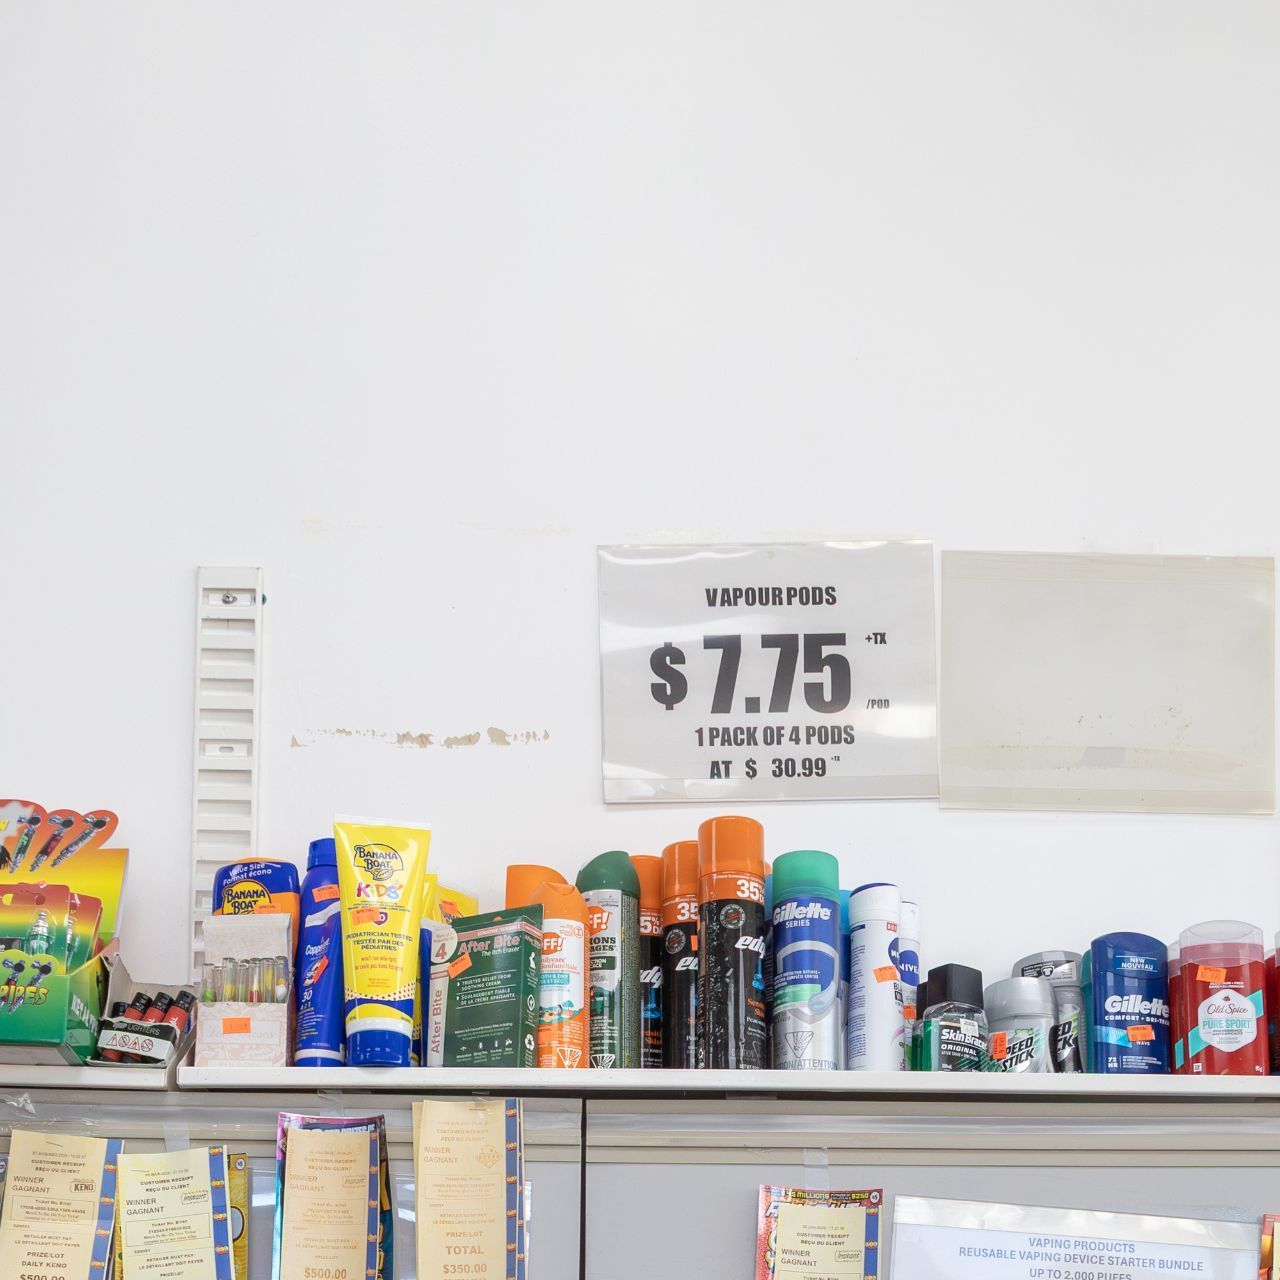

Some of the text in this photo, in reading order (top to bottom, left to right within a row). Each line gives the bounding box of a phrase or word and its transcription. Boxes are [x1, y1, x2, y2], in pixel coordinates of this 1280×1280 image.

[706, 586, 836, 607] VAPOUR PODS
[865, 633, 887, 645] +TX
[650, 633, 851, 713] $ 7.75
[867, 699, 890, 709] /POD
[695, 726, 855, 746] 1 PACK OF 4 PODS
[710, 758, 826, 779] AT $ 30.99
[357, 846, 398, 860] BANANA
[366, 859, 390, 869] BOAT
[773, 902, 831, 926] Gillette
[785, 919, 810, 928] SERIES
[457, 931, 520, 954] After Bite
[941, 1044, 976, 1056] ORIGINAL
[445, 1245, 484, 1256] TOTAL
[1029, 1238, 1135, 1254] VAPING PRODUCTS
[959, 1247, 1203, 1271] REUSABLE VAPING DEVICE STARTER BUNDLE
